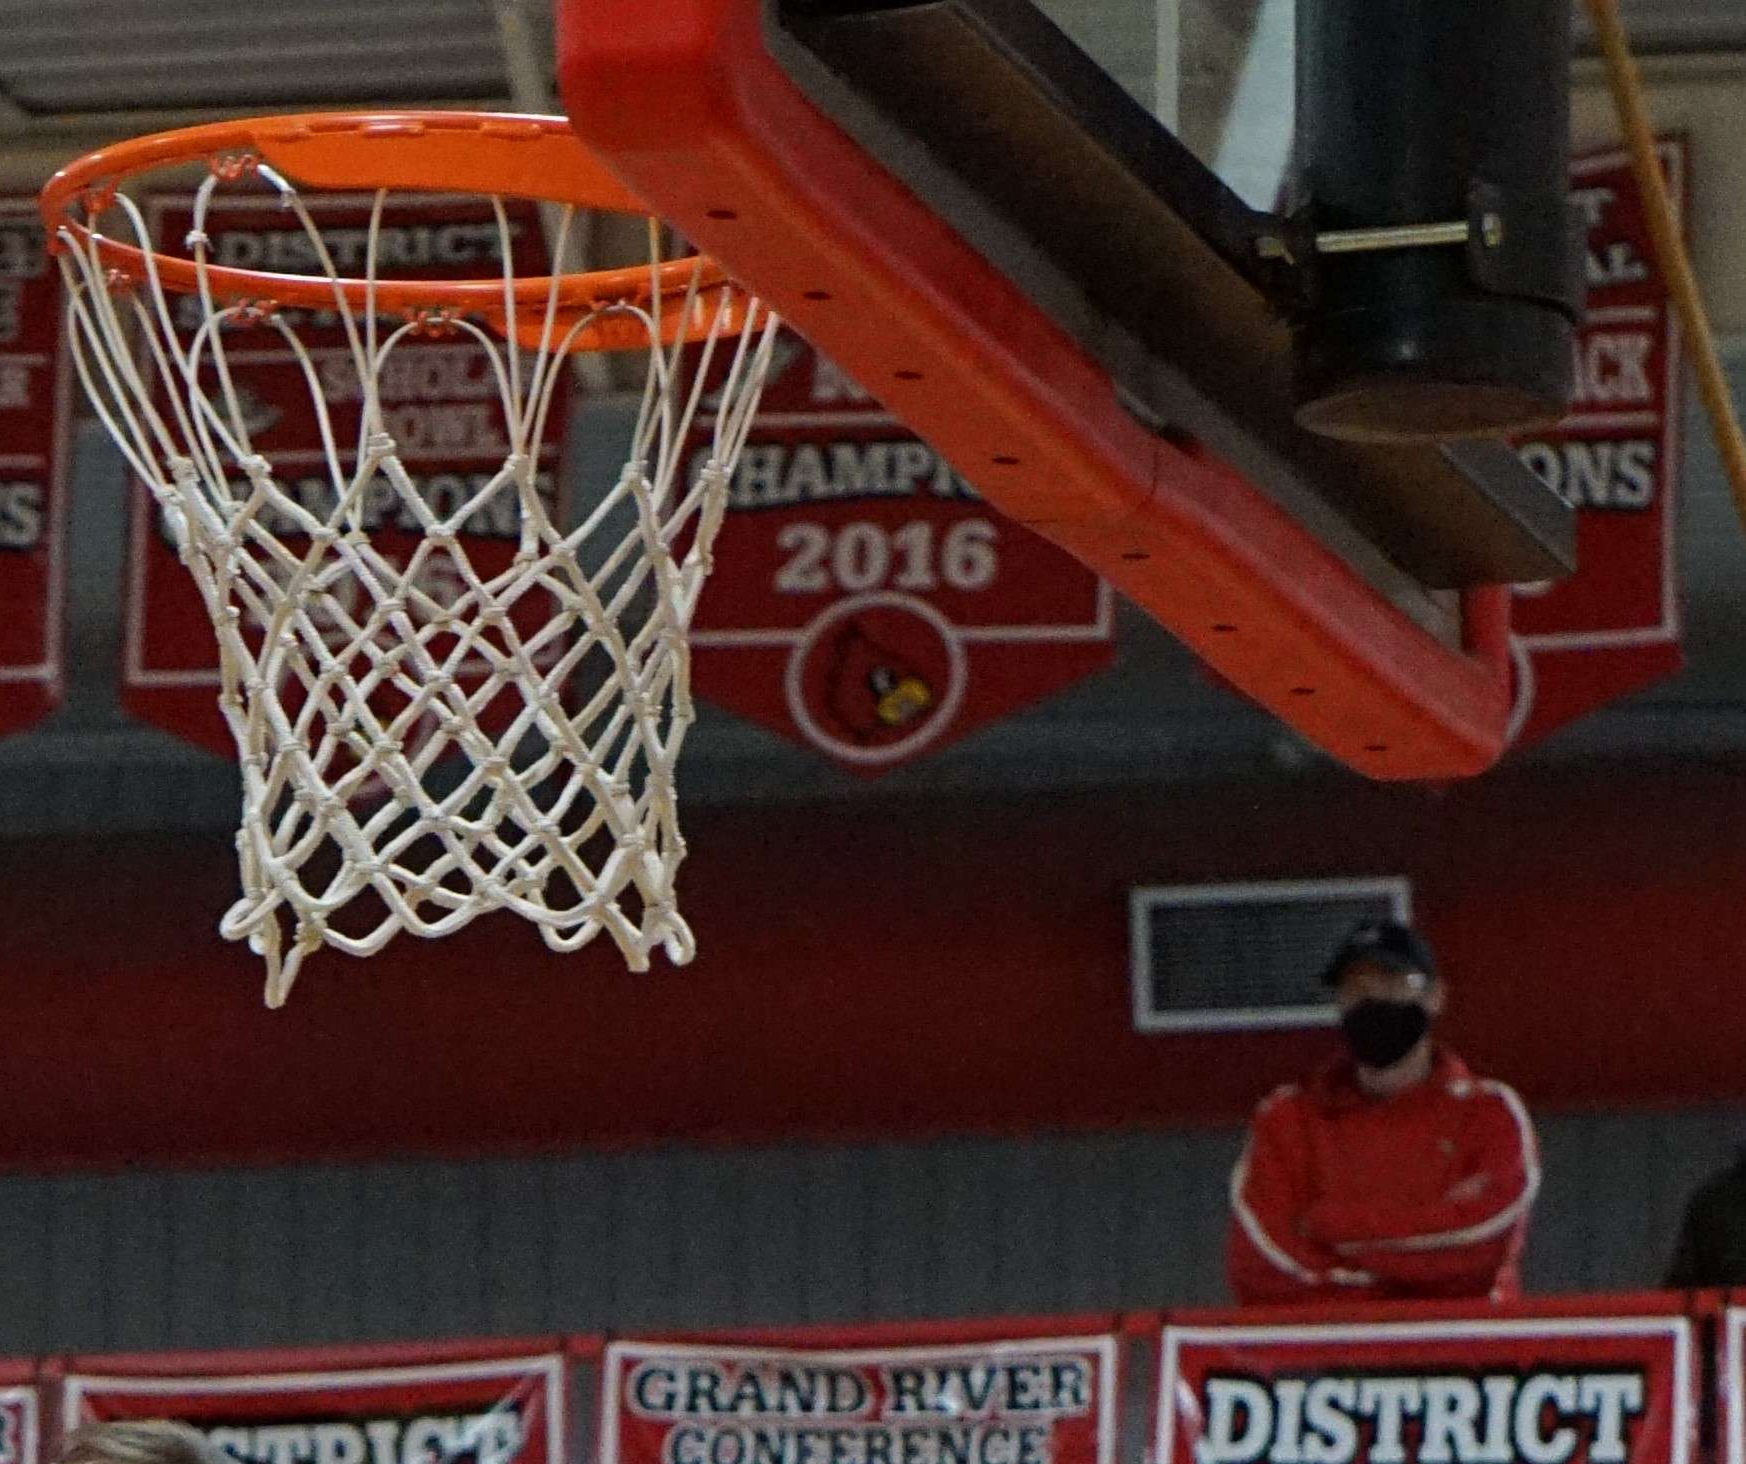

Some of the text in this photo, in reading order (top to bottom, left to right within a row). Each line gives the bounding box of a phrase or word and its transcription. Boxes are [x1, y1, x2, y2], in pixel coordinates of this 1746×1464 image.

[771, 517, 1001, 593] 2016
[630, 1355, 1092, 1420] GRAND RIVER
